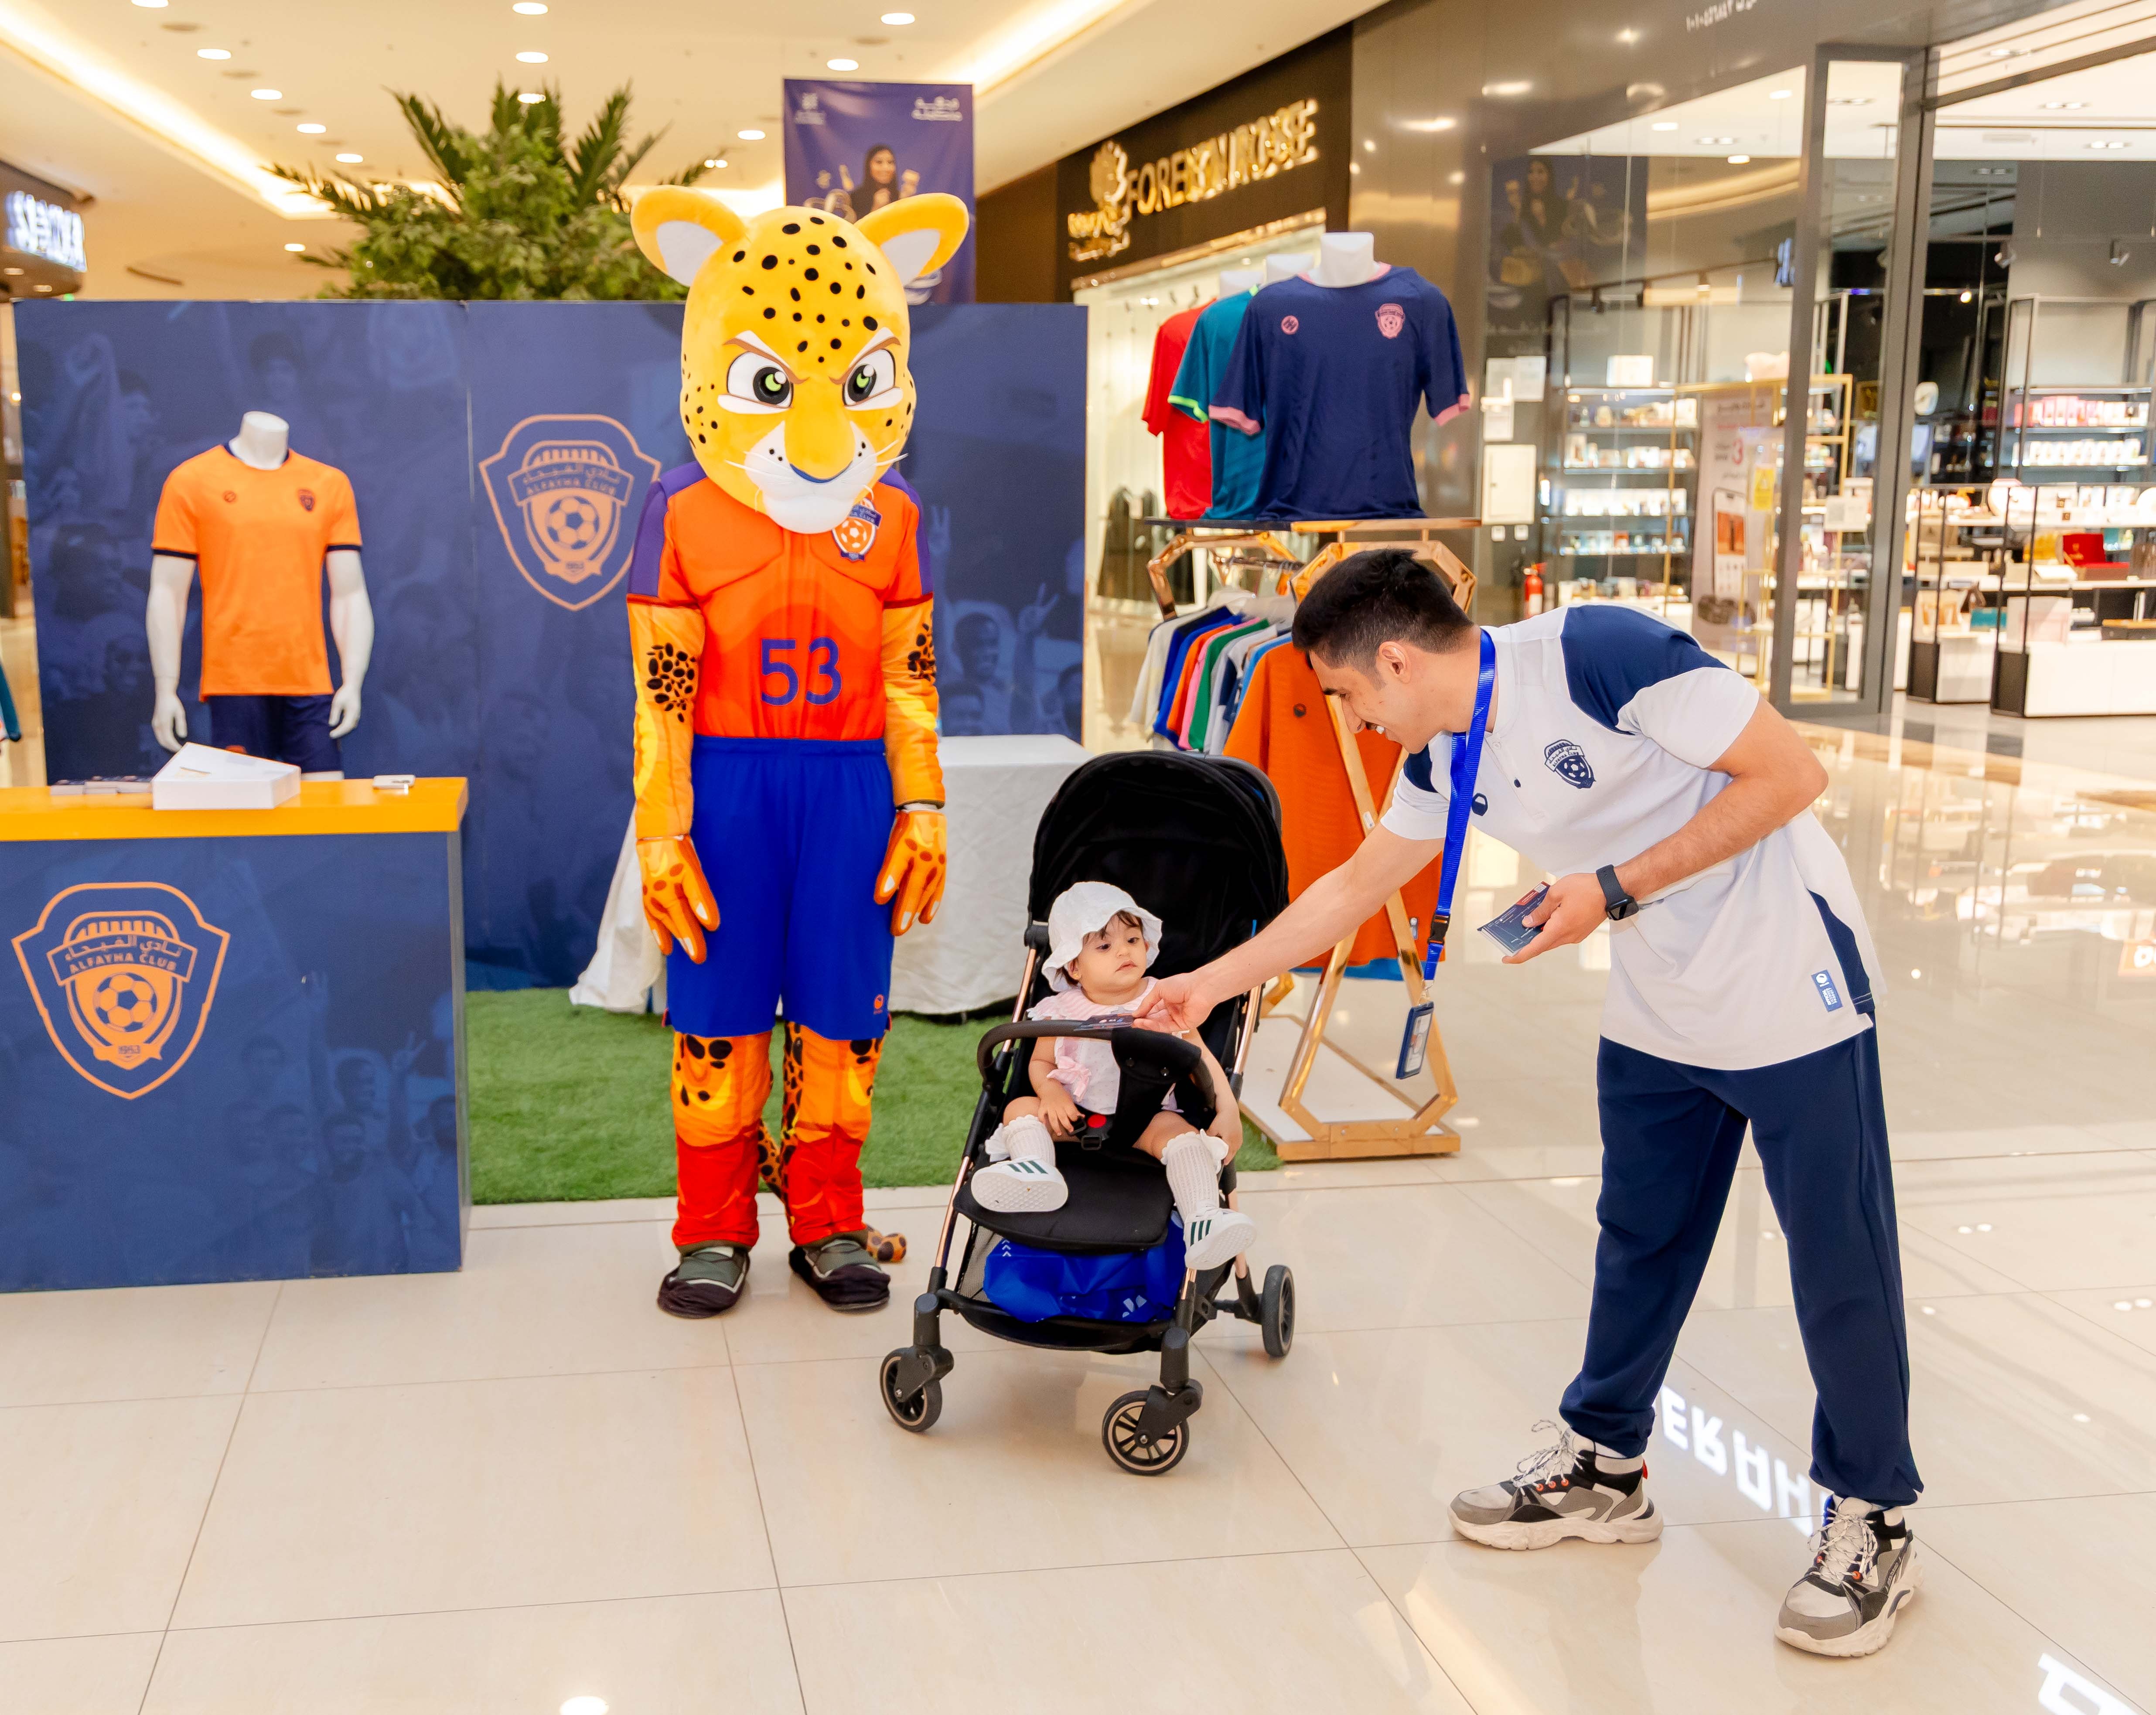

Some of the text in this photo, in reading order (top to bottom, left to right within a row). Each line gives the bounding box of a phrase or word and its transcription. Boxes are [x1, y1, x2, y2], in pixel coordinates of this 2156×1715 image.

[761, 636, 843, 706] 53
[69, 953, 177, 974] ALFAYHA CLUB
